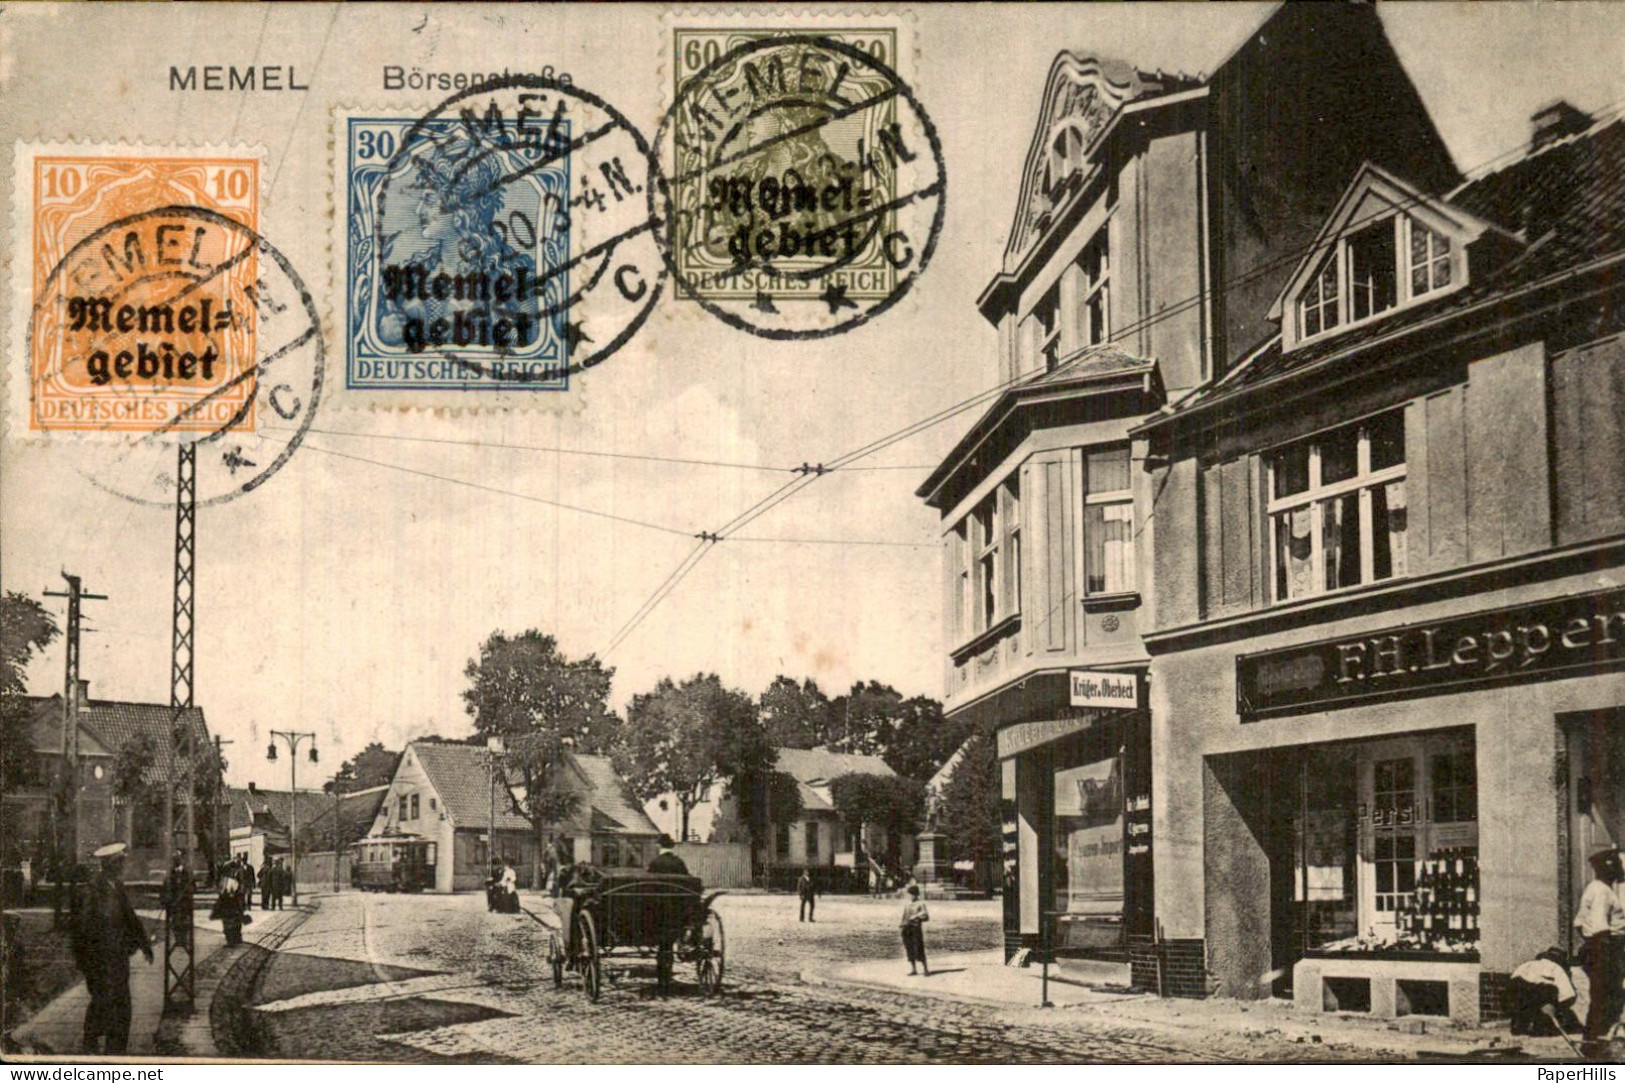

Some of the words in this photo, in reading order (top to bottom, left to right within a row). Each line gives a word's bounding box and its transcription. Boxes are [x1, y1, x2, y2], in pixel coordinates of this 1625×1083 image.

[685, 39, 721, 70] 60
[357, 130, 395, 160] 30
[43, 168, 82, 198] 10
[211, 169, 249, 199] 10
[883, 231, 914, 269] C
[614, 264, 647, 302] C
[684, 270, 812, 292] DEUTSCHES
[819, 270, 887, 292] REICH
[86, 342, 219, 386] gebiet
[357, 360, 484, 380] DEUTSCHES
[491, 361, 558, 380] REICH
[42, 402, 168, 422] DEUTSCHES
[175, 402, 248, 422] REICH
[268, 384, 302, 420] C
